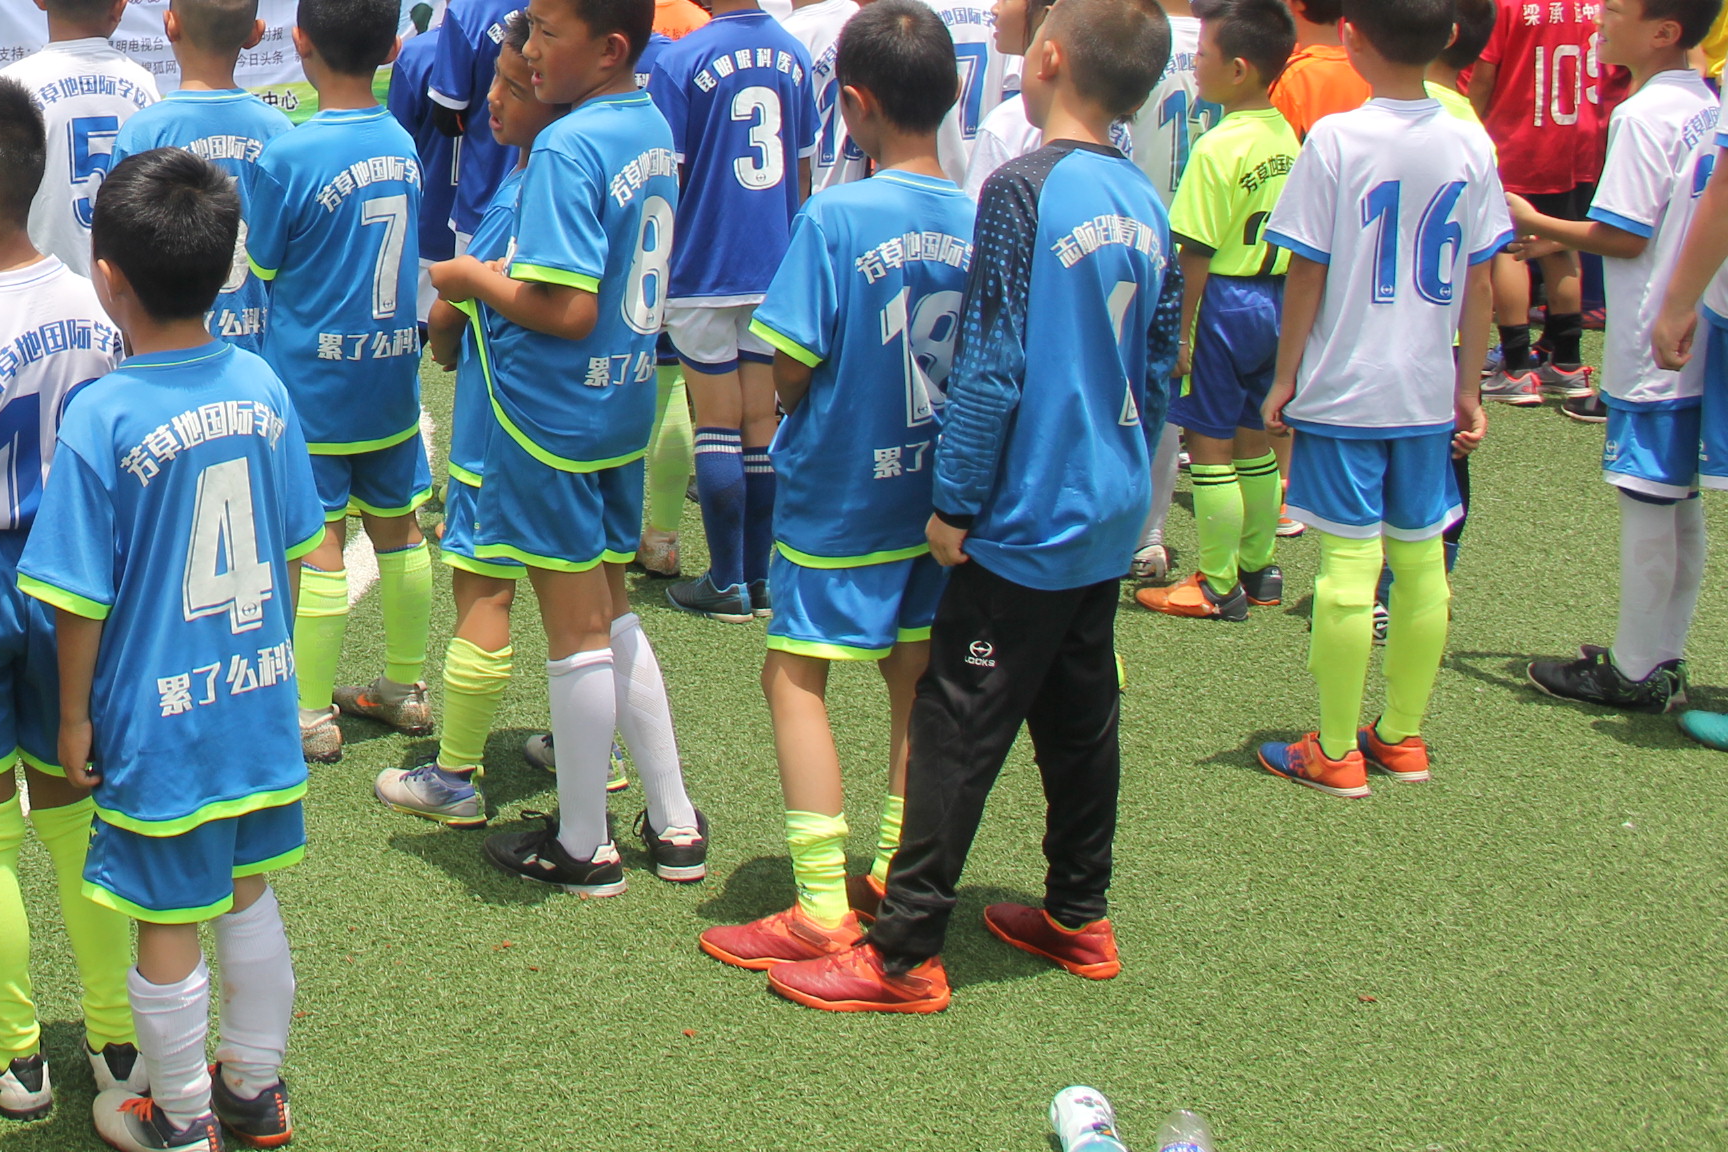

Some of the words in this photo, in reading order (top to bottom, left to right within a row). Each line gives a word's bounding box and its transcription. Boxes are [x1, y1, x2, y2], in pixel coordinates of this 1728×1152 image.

[237, 50, 284, 68] 今日头条
[251, 89, 299, 111] 中心
[181, 135, 263, 164] 地国际学
[730, 85, 784, 191] 3
[316, 155, 423, 213] 芳草地国际学
[360, 193, 408, 320] 7
[621, 195, 674, 336] 8
[1360, 179, 1469, 306] 16
[317, 325, 420, 361] 累了么科
[182, 456, 273, 635] 4
